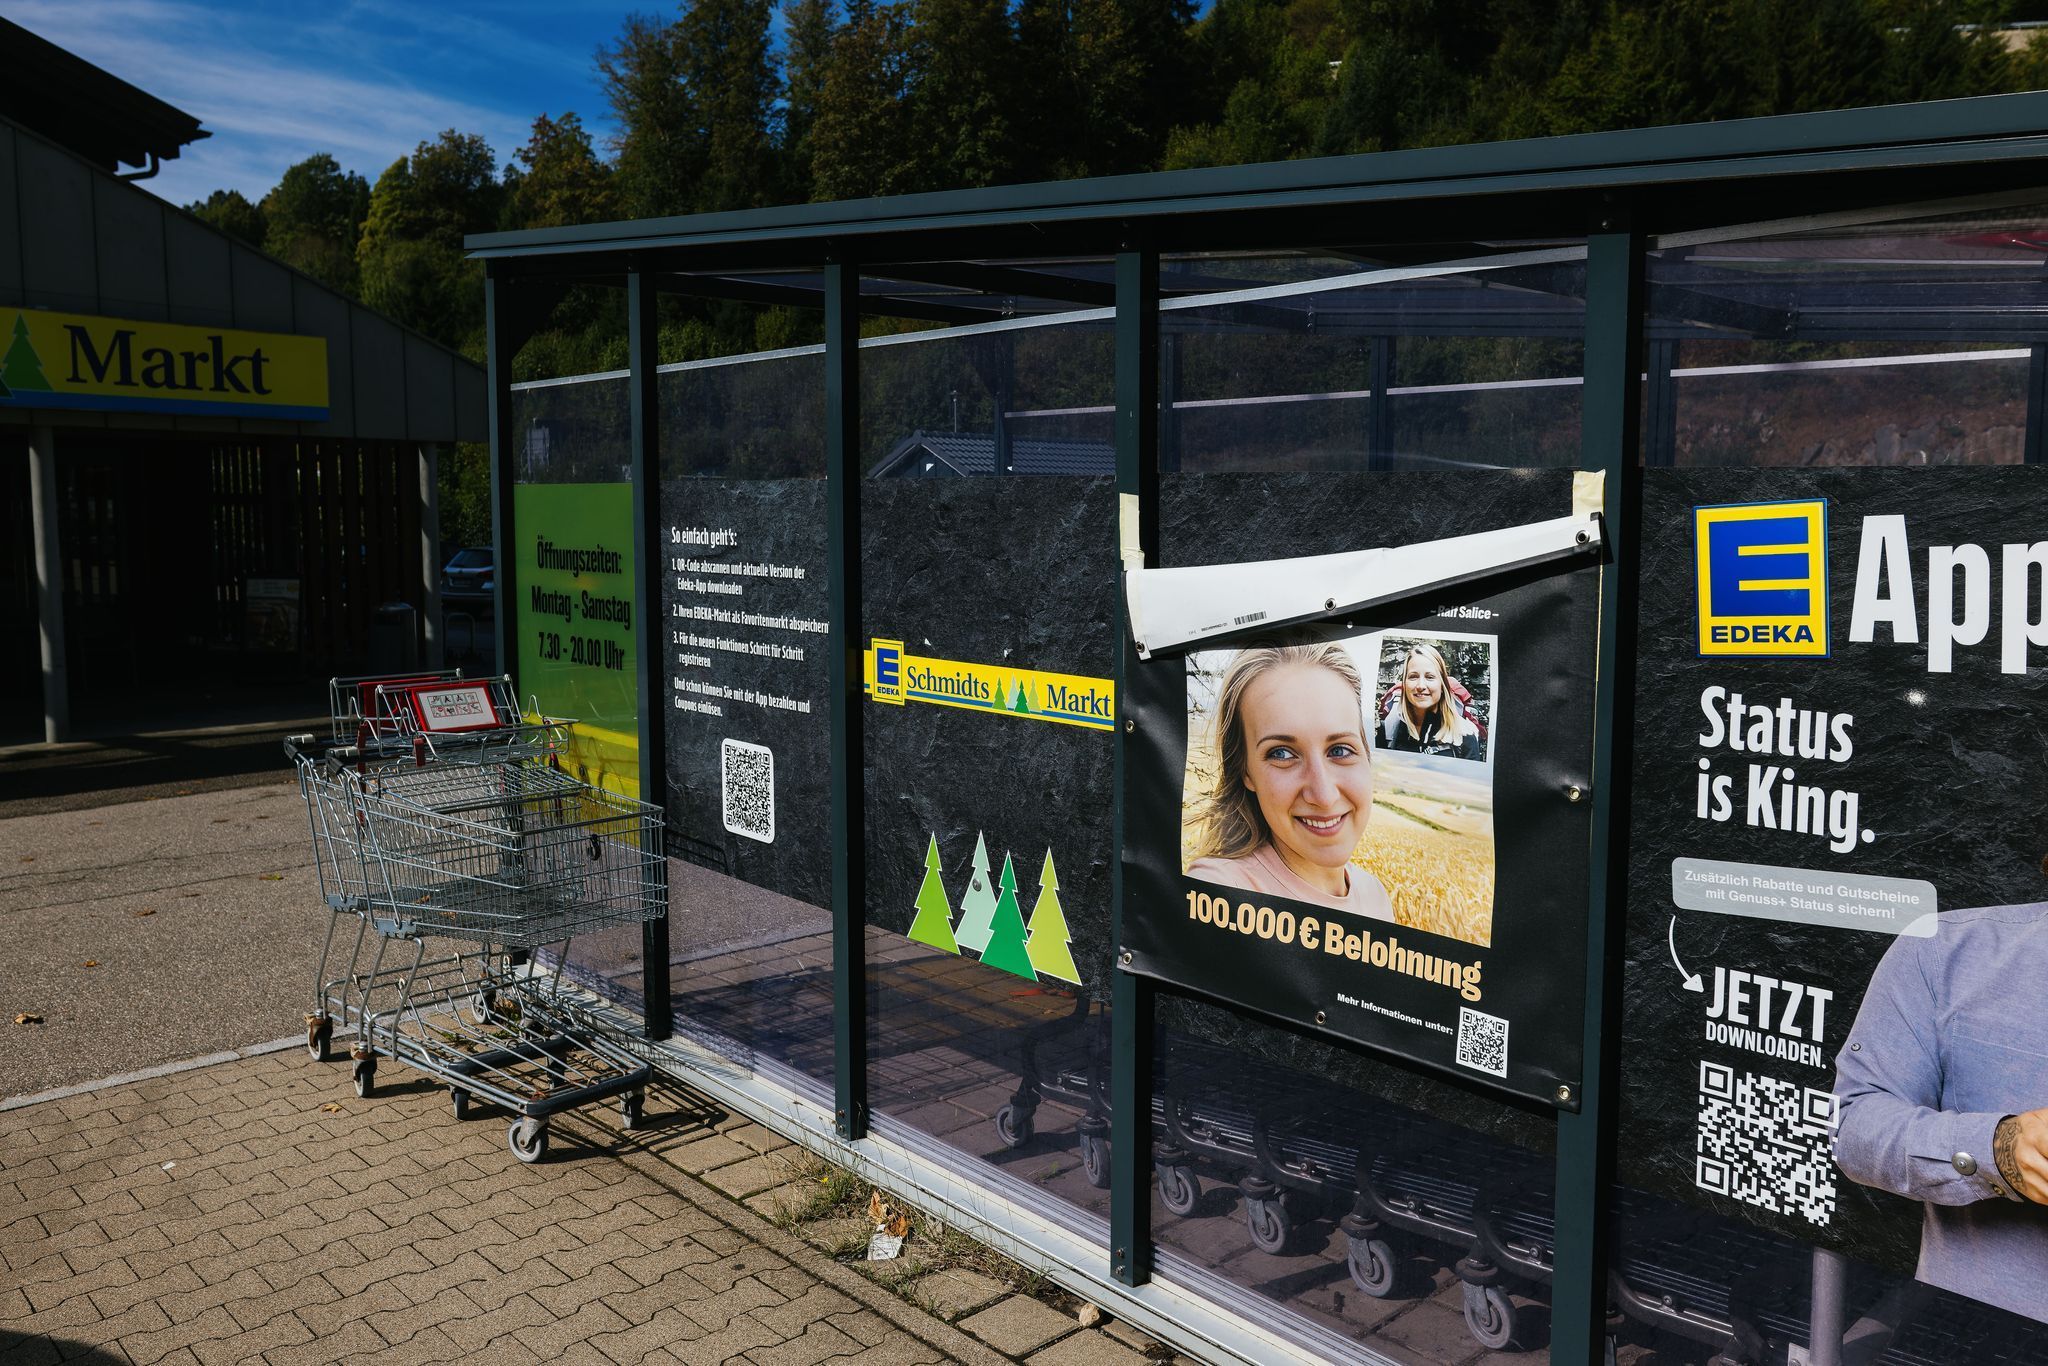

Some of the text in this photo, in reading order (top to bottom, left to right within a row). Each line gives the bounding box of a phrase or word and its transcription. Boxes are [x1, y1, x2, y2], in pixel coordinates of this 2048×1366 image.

[63, 324, 272, 396] Markt
[671, 526, 681, 544] So
[681, 526, 709, 545] einfach
[537, 535, 623, 578] Öffnungszeiten:
[671, 557, 806, 580] 1. QR-Code abscannen und aktuelle Version der
[677, 577, 743, 596] Edeka-App downloaden
[1848, 514, 2048, 673] App
[531, 585, 572, 623] Montag
[581, 589, 631, 631] Samstag
[678, 604, 693, 619] Ihren
[693, 605, 732, 623] EDEKA-Markt
[731, 610, 741, 624] als
[741, 611, 789, 629] Favoritenmarkt
[1458, 605, 1491, 620] Salice
[538, 631, 560, 661] 7.30
[570, 635, 602, 668] 20.00
[603, 639, 625, 671] Uhr
[673, 630, 804, 661] 3. Für die neuen Funktionen Schritt für Schritt
[1710, 625, 1815, 644] EDEKA
[679, 651, 711, 668] registrieren
[674, 676, 811, 714] Und schon können Sie mit der App bezahlen und
[674, 695, 723, 717] Coupons einlösen.
[876, 686, 900, 697] EDEKA
[906, 665, 1111, 717] Schmidts Markt
[1699, 685, 1854, 764] Status
[1696, 757, 1876, 855] is King.
[1684, 869, 1921, 905] Zusätzlich Rabatte und Gutscheine
[1705, 888, 1897, 919] mit Genuss+ Status sichern!
[1185, 889, 1483, 1003] 100.000 € Belohnung
[1337, 992, 1455, 1036] Mehr Informationen unter:
[1706, 966, 1834, 1043] JETZT
[1705, 1020, 1828, 1070] DOWNLOADEN.
